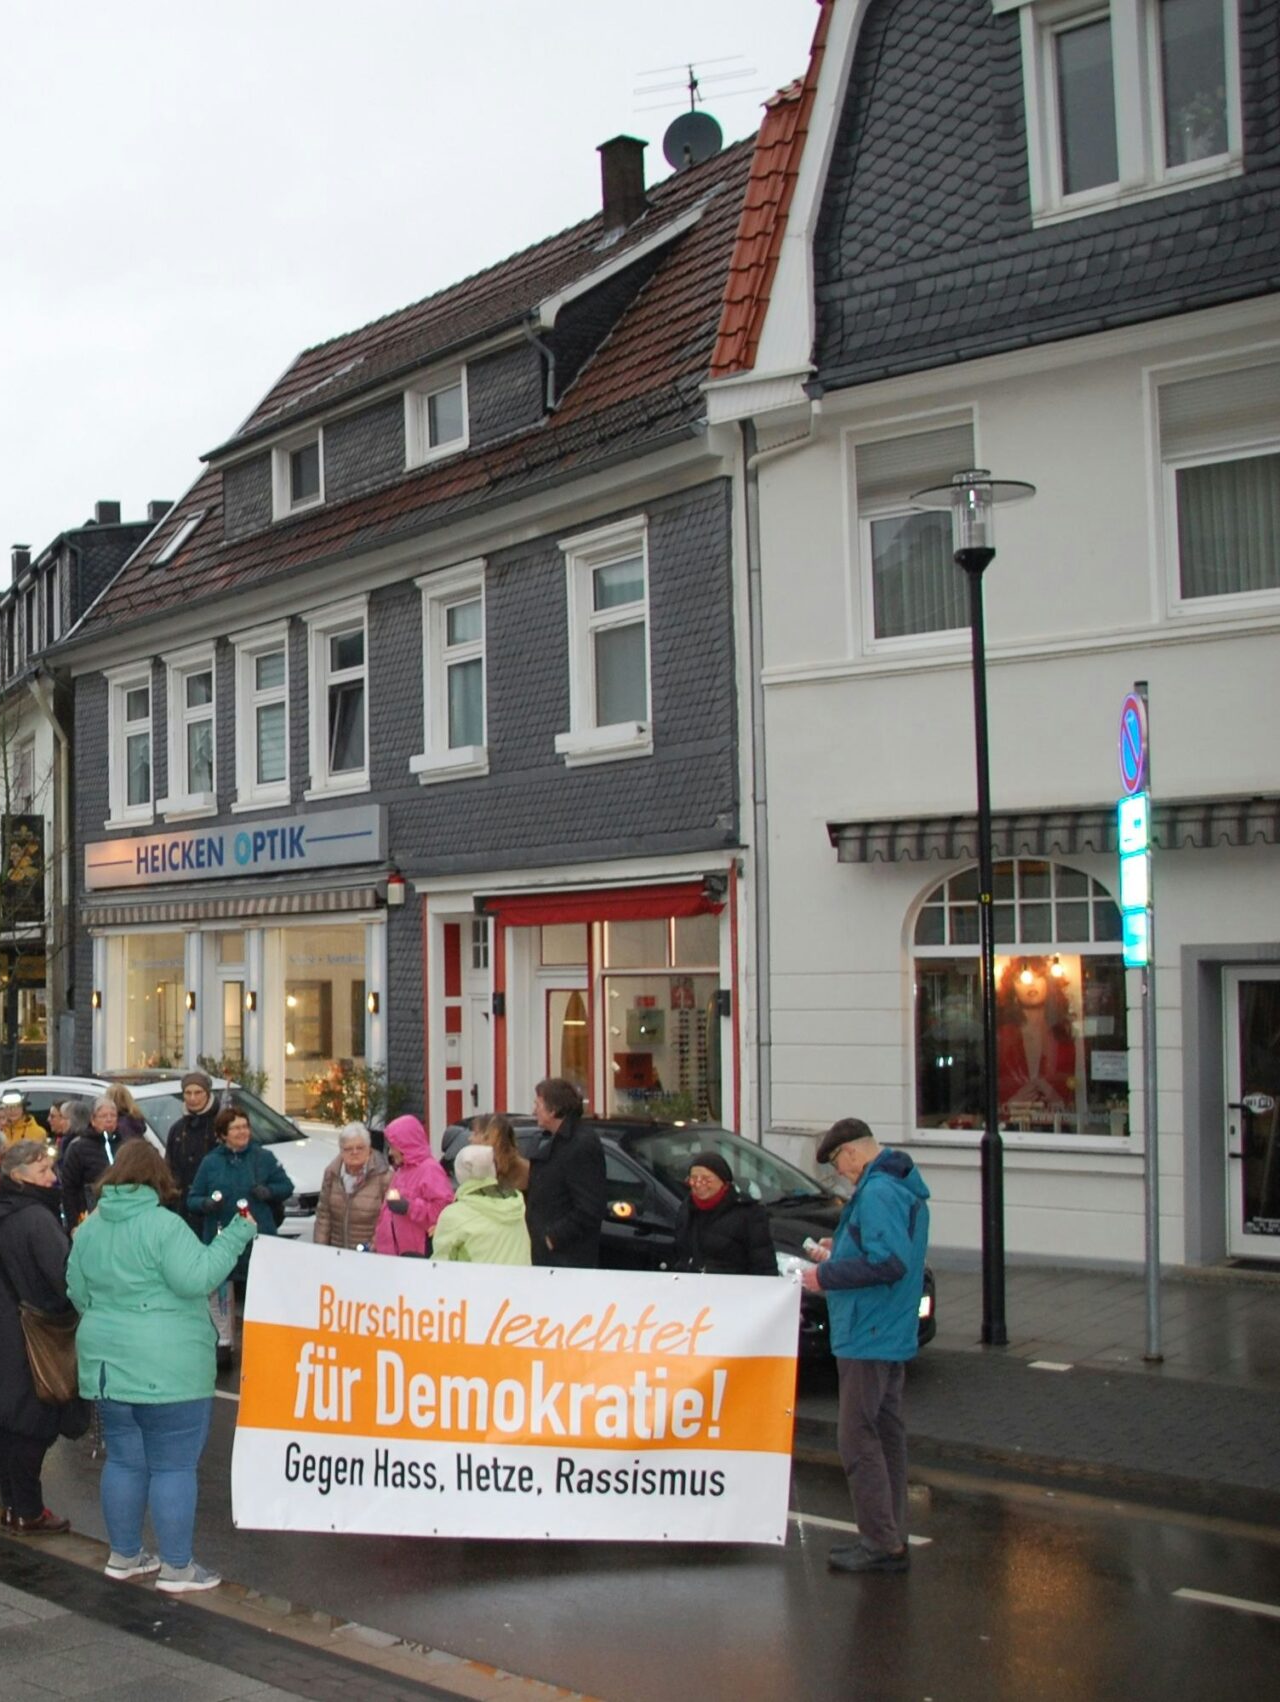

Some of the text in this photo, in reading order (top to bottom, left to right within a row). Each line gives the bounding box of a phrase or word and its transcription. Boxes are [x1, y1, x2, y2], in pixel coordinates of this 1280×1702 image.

[136, 825, 305, 874] HEICKEN OPTIK
[319, 1284, 714, 1356] Burscheid leuchtet
[293, 1341, 728, 1440] für Demokratie!
[285, 1442, 726, 1497] Gegen Hass, Hetze, Rassismus
